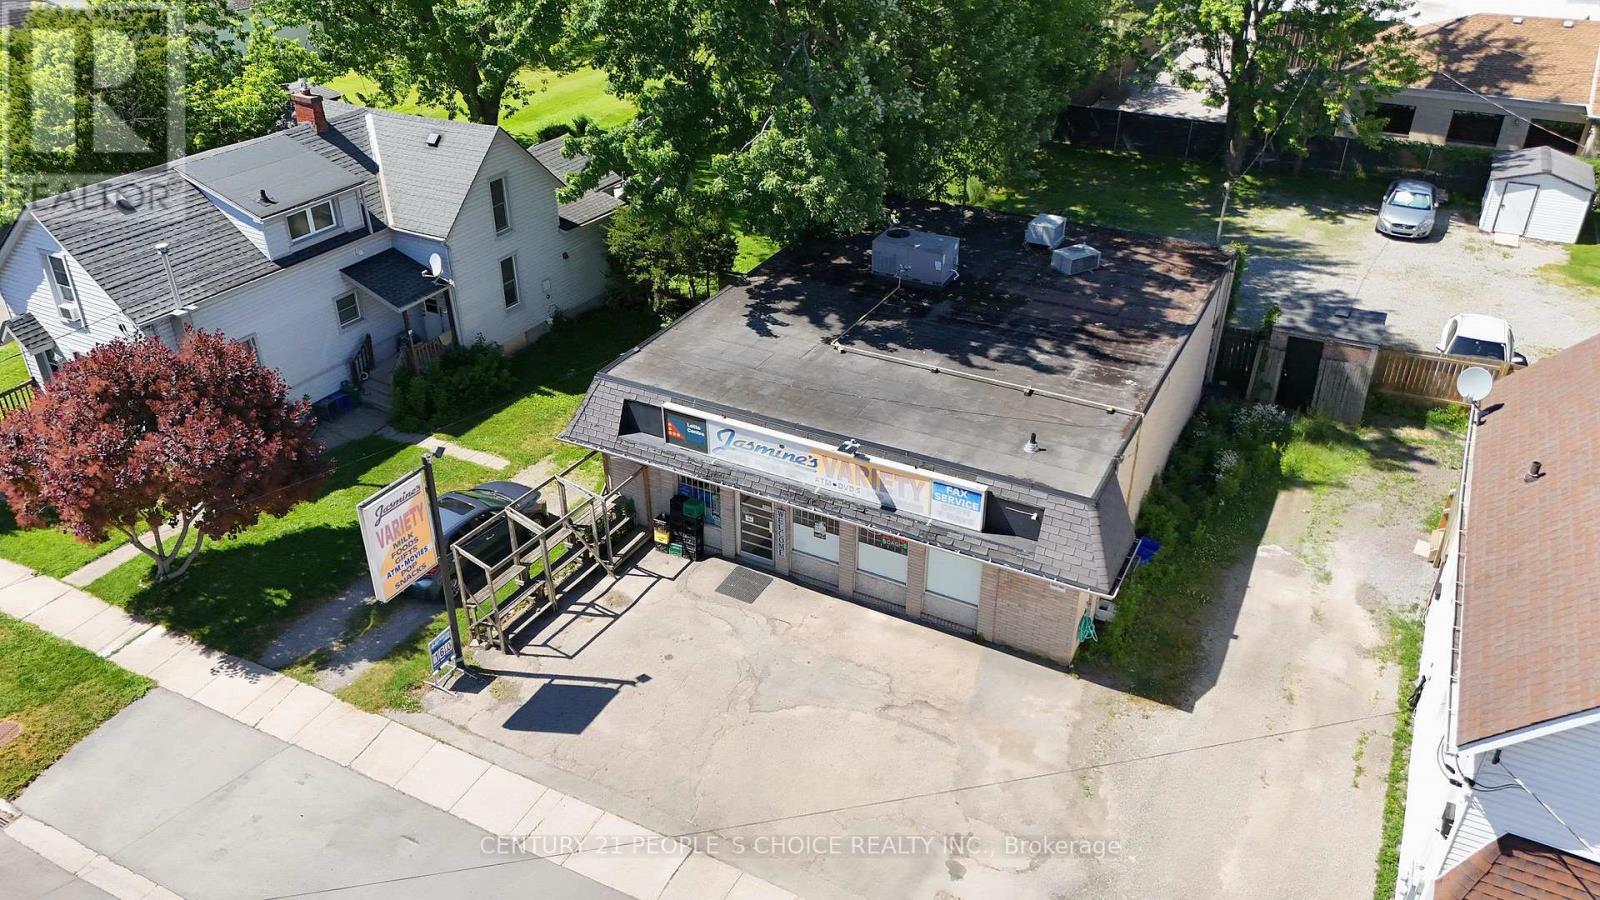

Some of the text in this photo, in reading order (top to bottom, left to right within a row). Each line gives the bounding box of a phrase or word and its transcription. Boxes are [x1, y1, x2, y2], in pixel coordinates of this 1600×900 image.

[712, 428, 818, 468] Jasmine's
[822, 455, 926, 503] VARIETY
[934, 493, 980, 510] SERVICE
[946, 487, 968, 498] FAX
[374, 485, 421, 527] Jasmine's
[376, 502, 424, 548] VARIETY
[777, 510, 785, 556] WELCOME
[391, 536, 419, 559] FOODS
[393, 532, 414, 549] MILK
[395, 545, 418, 564] GIFTS
[395, 563, 427, 589] SNACKS
[400, 561, 417, 577] POP
